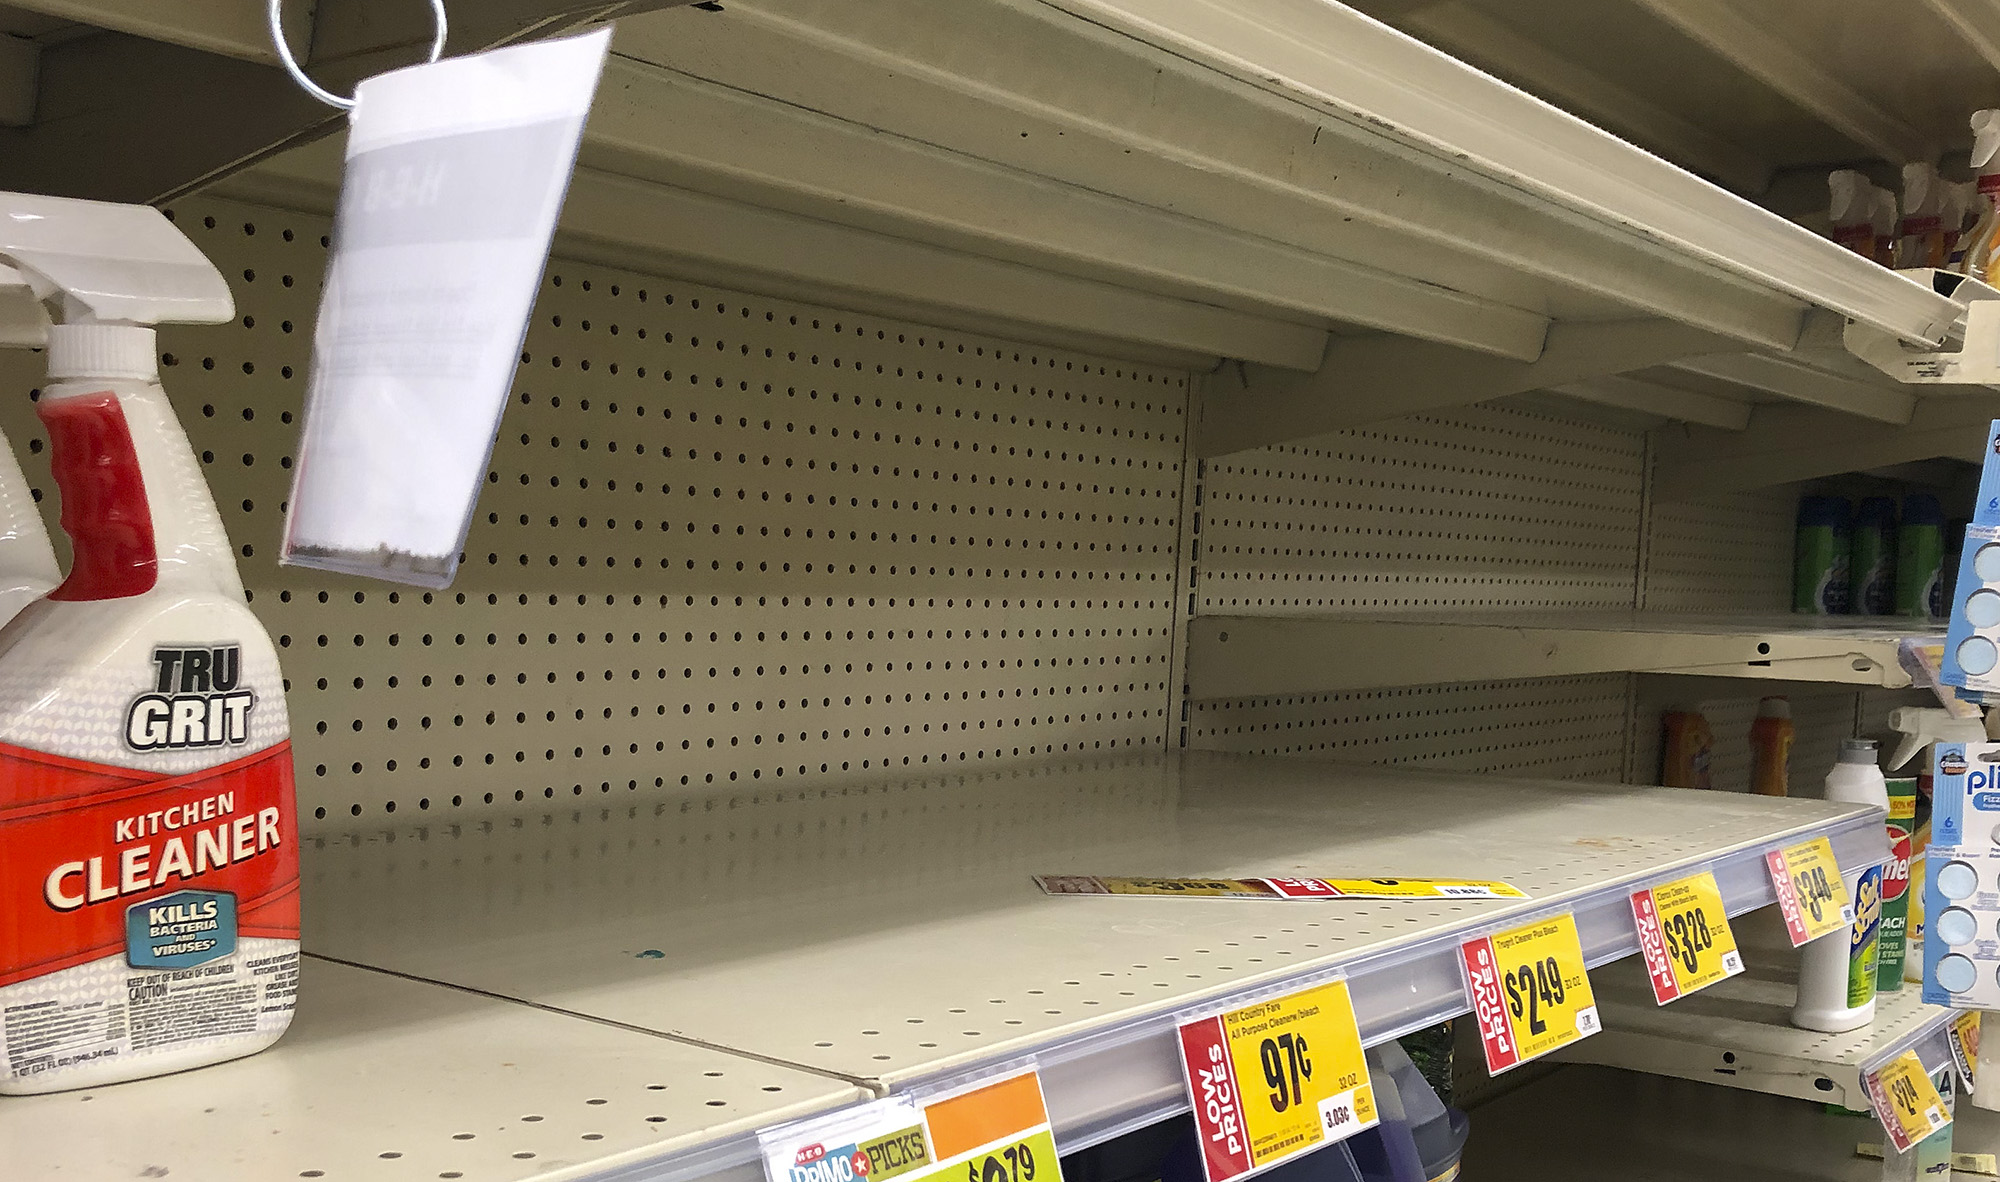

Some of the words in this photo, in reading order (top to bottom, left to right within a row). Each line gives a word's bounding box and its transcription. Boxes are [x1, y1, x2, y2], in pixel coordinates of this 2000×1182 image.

[154, 647, 240, 693] TRU
[127, 692, 252, 749] GRIT
[115, 791, 235, 843] KITCHEN
[1944, 817, 1954, 829] 6
[44, 806, 281, 912] CLEANER
[149, 901, 218, 925] KILLS
[150, 920, 218, 937] BACTERIA
[175, 934, 195, 942] AND
[1638, 917, 1660, 977] LOW
[1664, 907, 1712, 974] $328
[127, 976, 145, 988] KEEP
[146, 974, 161, 985] OUT
[161, 973, 171, 983] OF
[172, 970, 193, 981] REACH
[194, 968, 205, 978] OF
[204, 964, 235, 977] CHILDREN
[129, 983, 168, 1000] CAUTION
[1477, 948, 1510, 1053] PRICES
[1505, 956, 1565, 1036] $249
[1239, 1007, 1266, 1021] Country
[1265, 1003, 1281, 1013] Fare
[1471, 970, 1496, 1041] LOW
[1231, 1028, 1241, 1040] All
[1241, 1022, 1268, 1036] Purpose
[1260, 1032, 1312, 1113] 97¢
[1338, 1076, 1348, 1090] 32
[1347, 1073, 1358, 1087] OZ
[1198, 1068, 1226, 1143] LOW
[1208, 1043, 1243, 1156] PRICES
[866, 1132, 926, 1175] PICKS
